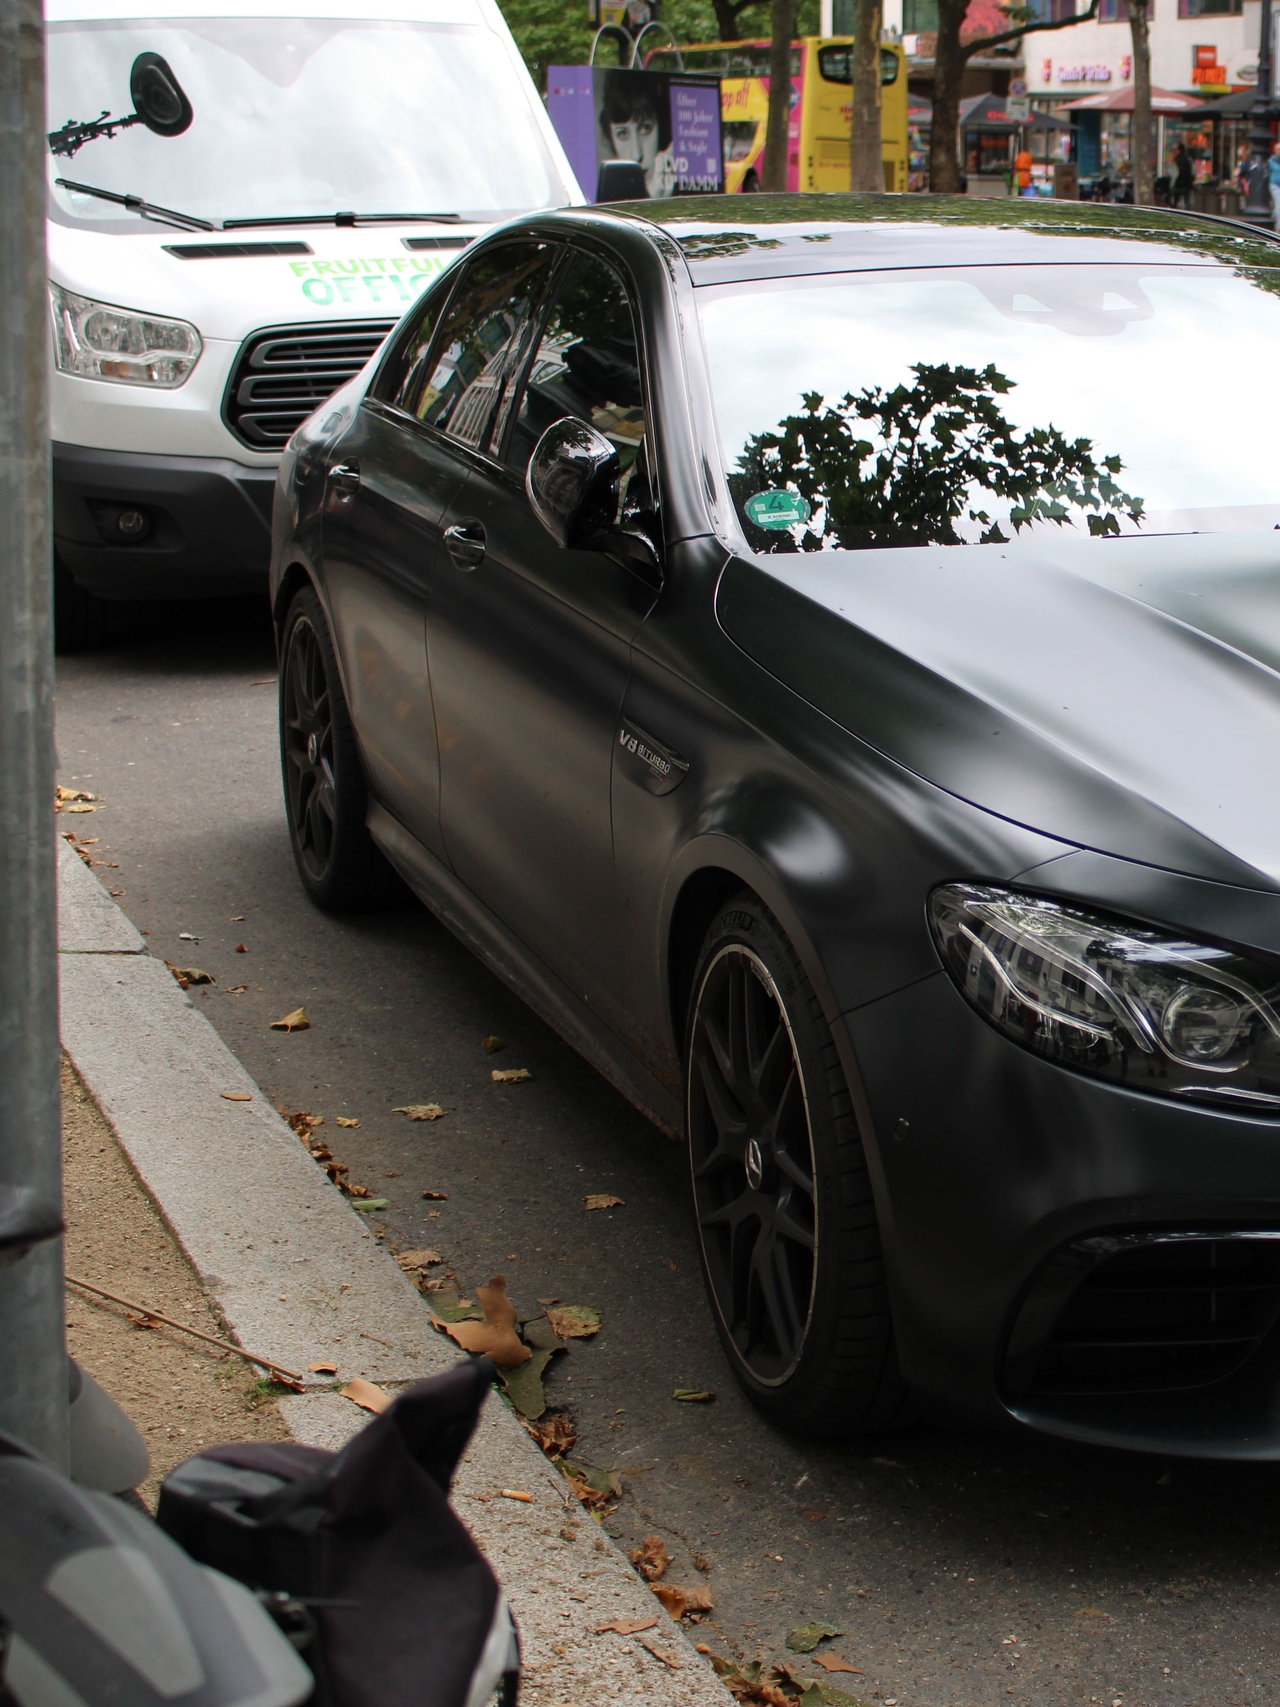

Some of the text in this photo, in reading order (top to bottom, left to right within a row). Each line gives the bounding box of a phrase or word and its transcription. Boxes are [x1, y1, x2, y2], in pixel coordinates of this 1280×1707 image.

[769, 495, 784, 510] 4
[619, 729, 638, 753] V8
[637, 744, 671, 773] BITURBO
